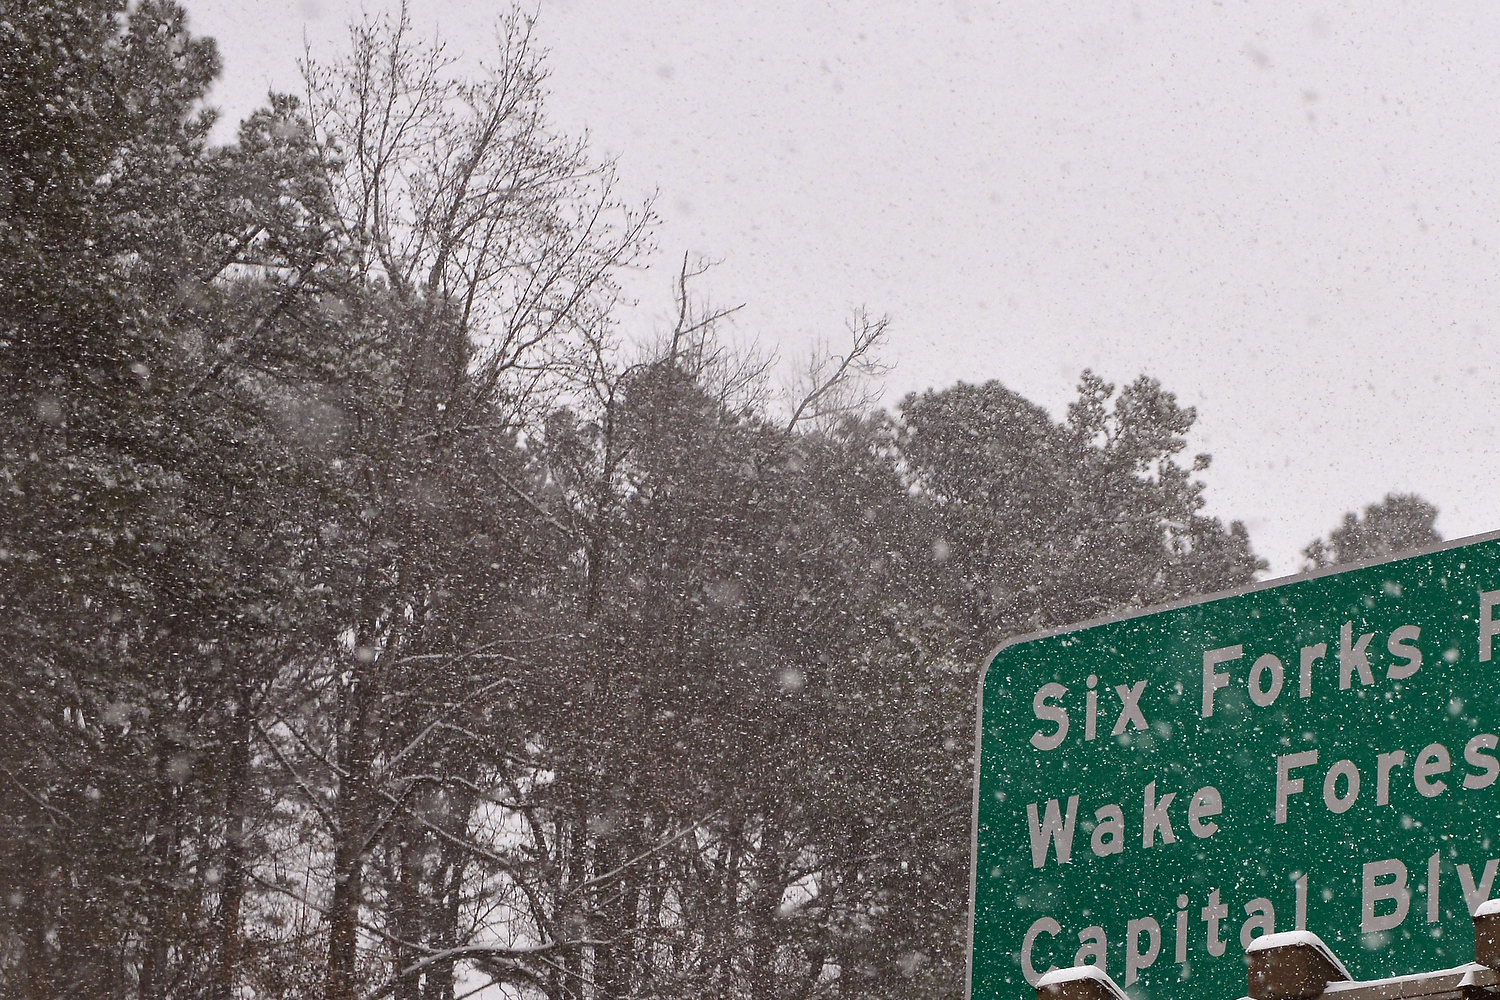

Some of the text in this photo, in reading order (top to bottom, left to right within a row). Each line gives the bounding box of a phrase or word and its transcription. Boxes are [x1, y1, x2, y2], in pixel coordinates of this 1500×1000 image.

[1030, 674, 1149, 752] Six
[1202, 621, 1423, 718] Forks
[1026, 780, 1223, 869] Wake
[1021, 873, 1308, 988] Capital
